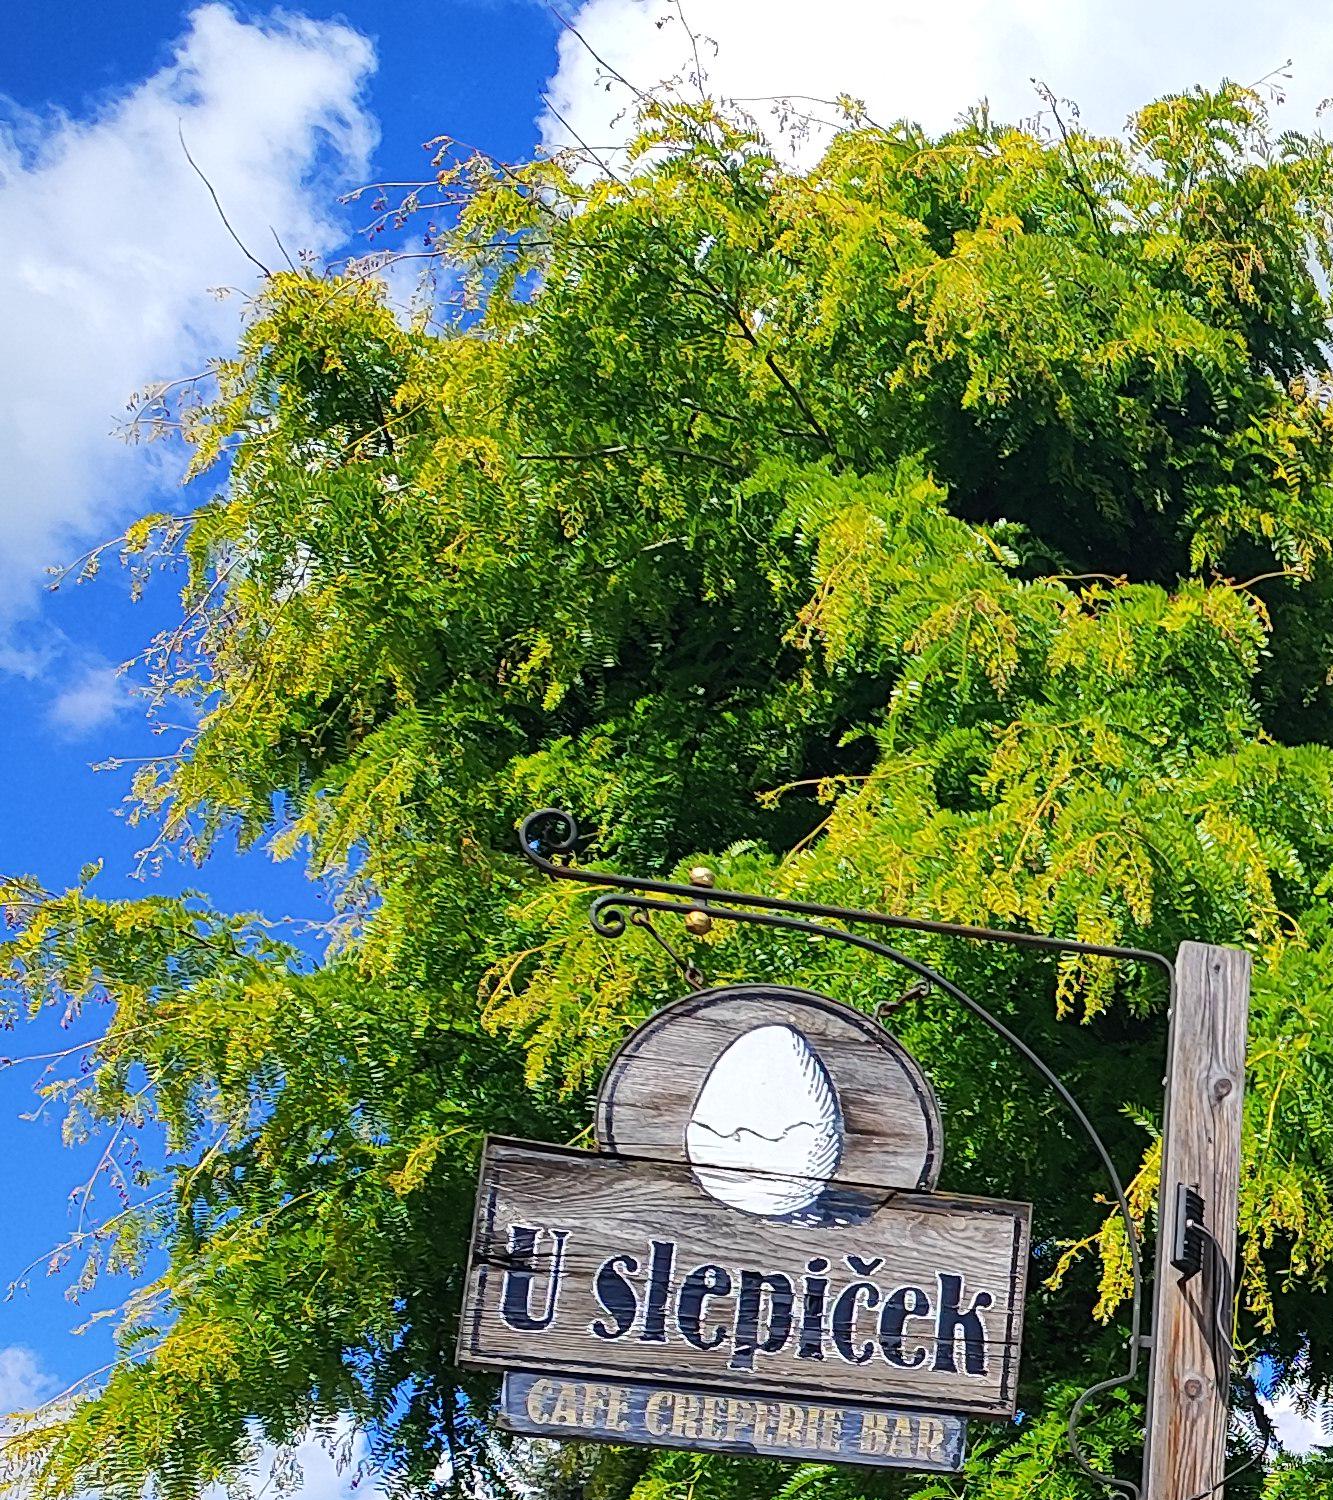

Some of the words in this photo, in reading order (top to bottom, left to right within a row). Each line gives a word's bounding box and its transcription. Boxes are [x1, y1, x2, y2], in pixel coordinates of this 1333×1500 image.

[500, 1222, 573, 1333] U
[591, 1238, 996, 1379] slepiček
[525, 1378, 635, 1433] CAFE
[643, 1390, 844, 1453] CREPERIE
[859, 1411, 948, 1464] BAR
